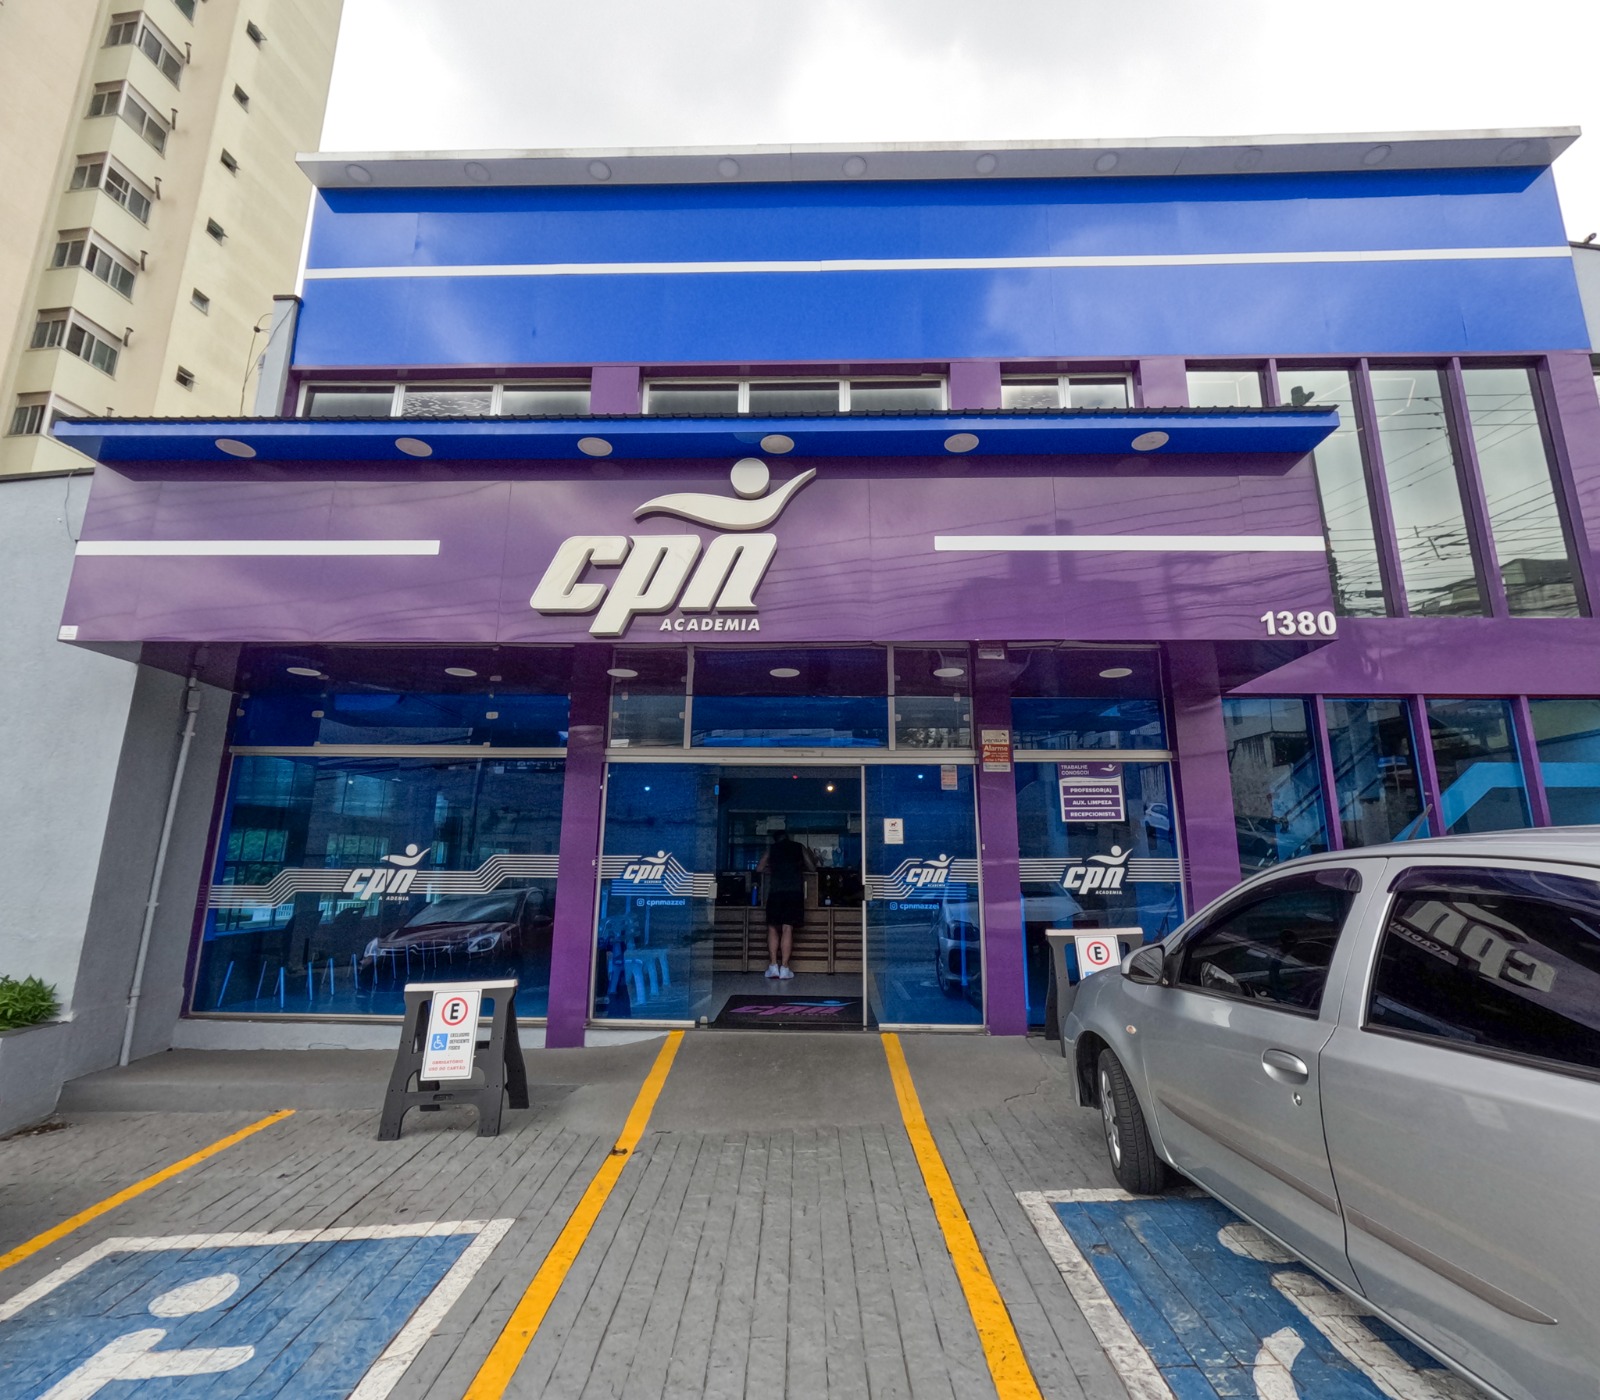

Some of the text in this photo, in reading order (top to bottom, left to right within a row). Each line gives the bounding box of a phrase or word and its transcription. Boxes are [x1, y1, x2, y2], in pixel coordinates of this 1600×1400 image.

[659, 618, 760, 632] ACADEMIA
[1260, 610, 1337, 636] 1380
[1093, 946, 1103, 960] E
[449, 1003, 460, 1020] E
